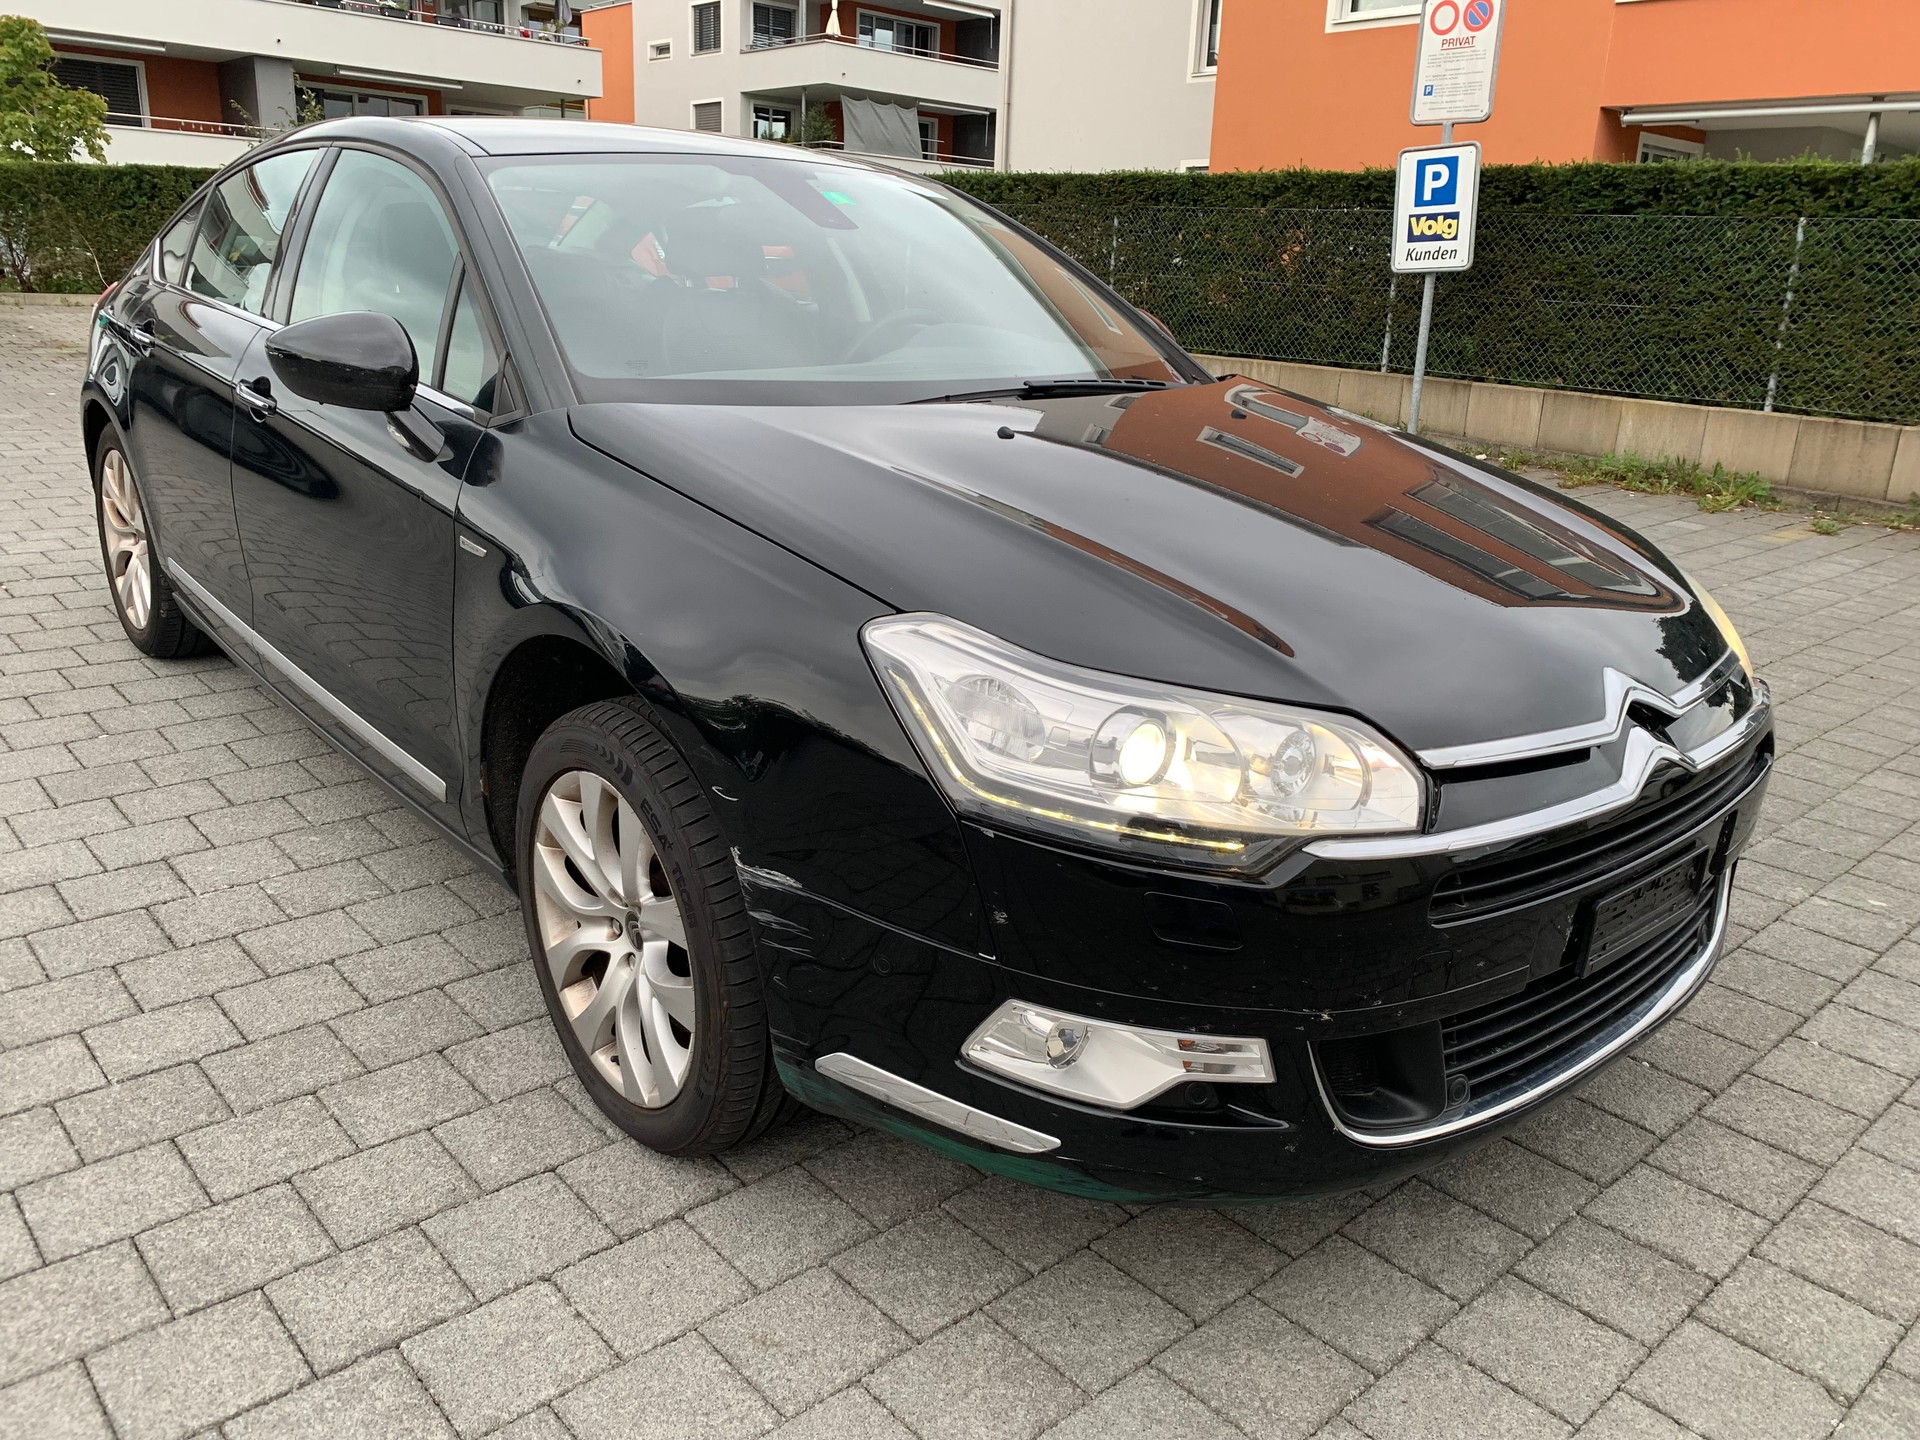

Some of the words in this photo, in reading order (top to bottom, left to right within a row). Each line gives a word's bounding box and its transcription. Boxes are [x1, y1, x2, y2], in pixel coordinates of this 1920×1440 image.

[1441, 35, 1476, 48] PRIVAT
[1423, 164, 1450, 201] P
[1410, 215, 1458, 239] Volg
[1405, 246, 1458, 262] Kunden
[671, 861, 698, 929] TECAR
